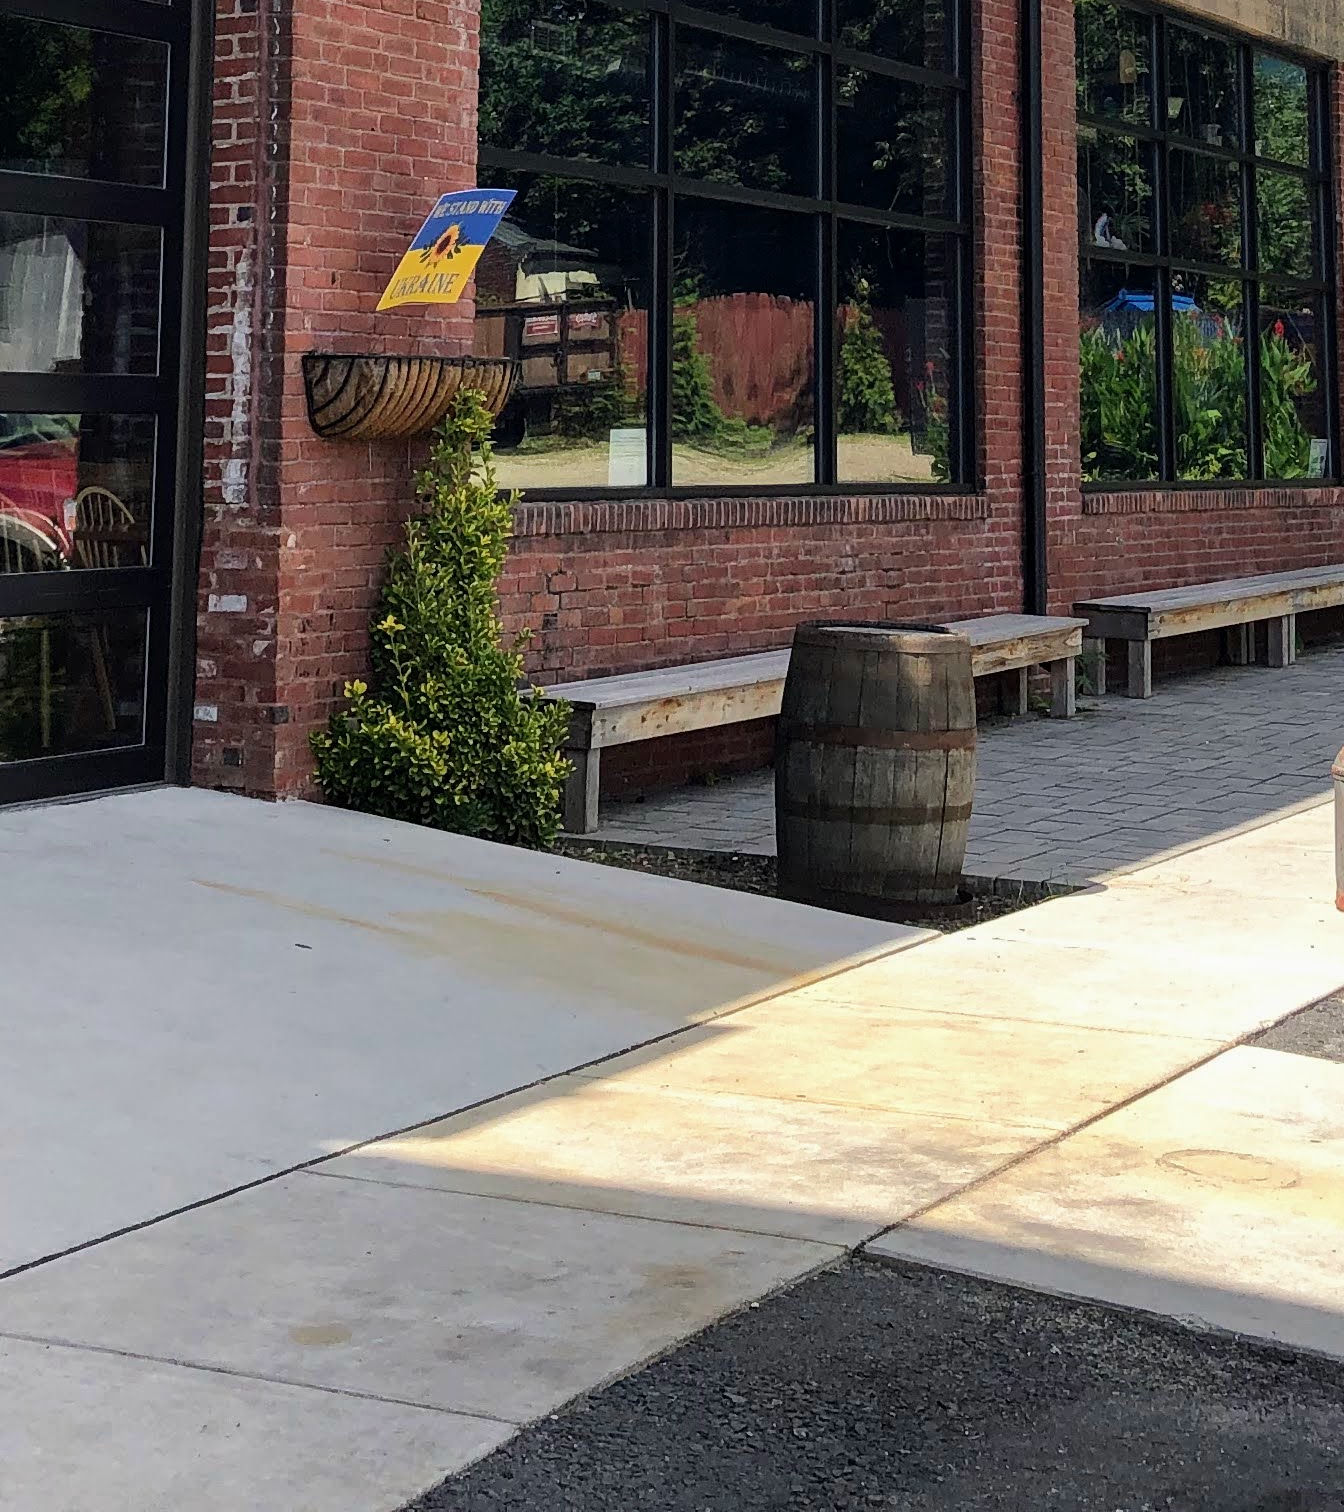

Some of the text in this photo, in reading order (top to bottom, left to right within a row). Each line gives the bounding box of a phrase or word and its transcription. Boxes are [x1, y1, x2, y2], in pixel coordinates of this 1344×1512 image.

[433, 198, 507, 219] WE STAND WITH
[390, 273, 460, 299] UKRAINE
